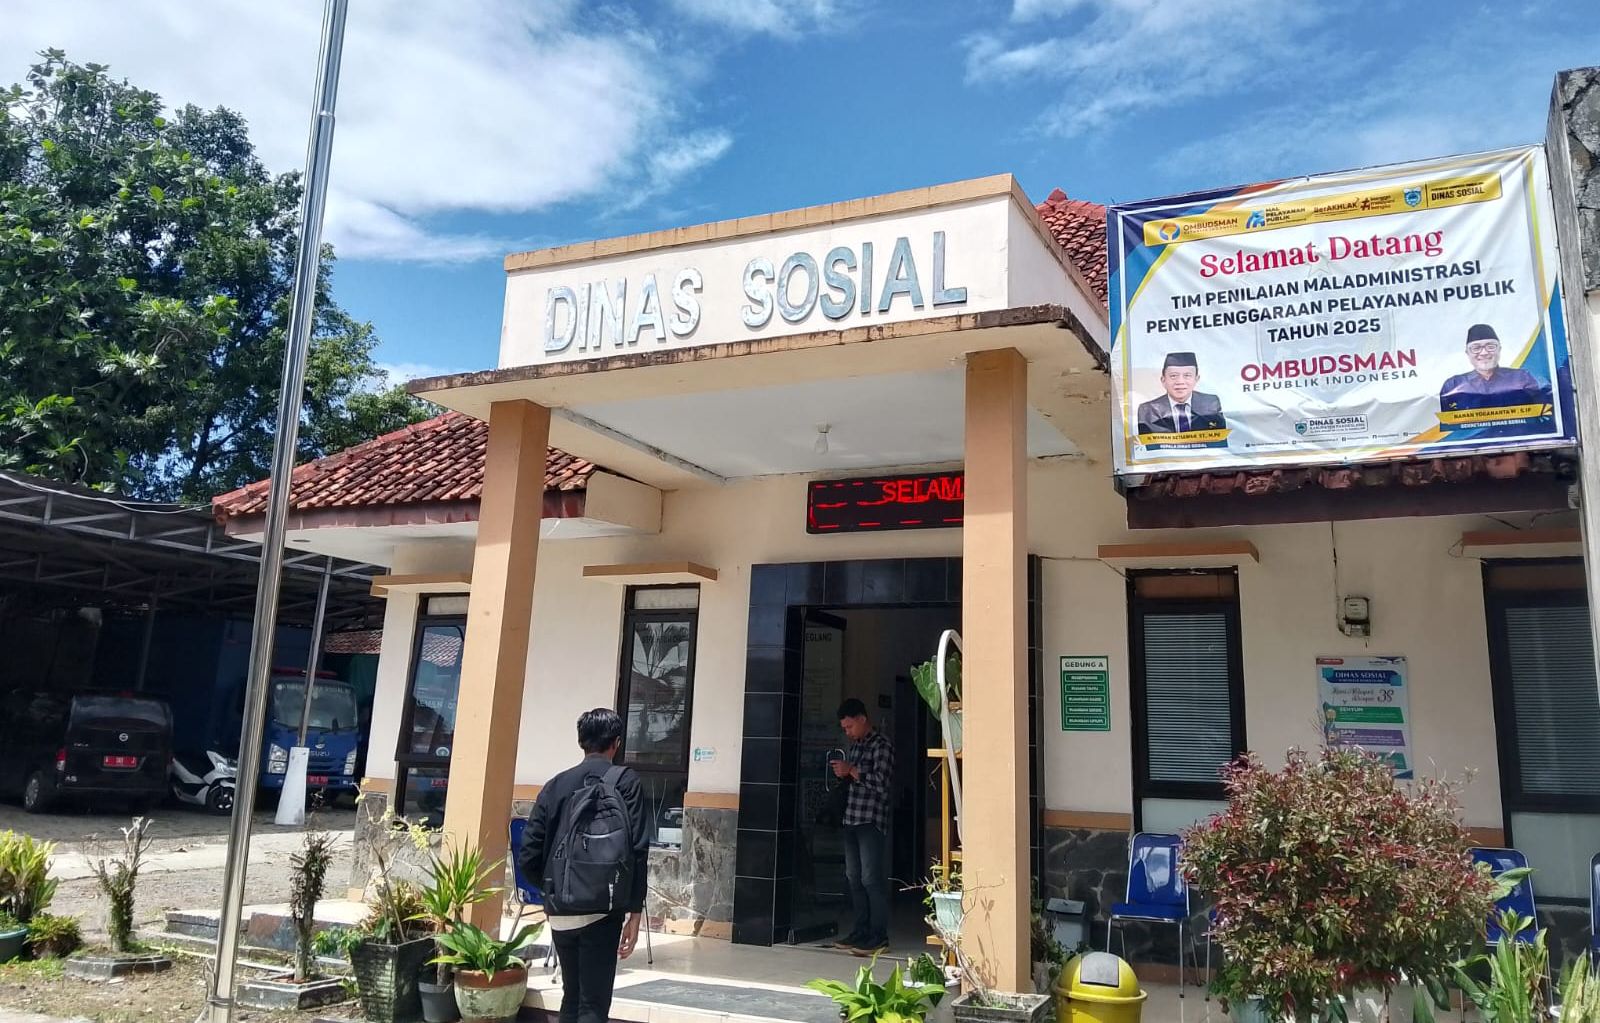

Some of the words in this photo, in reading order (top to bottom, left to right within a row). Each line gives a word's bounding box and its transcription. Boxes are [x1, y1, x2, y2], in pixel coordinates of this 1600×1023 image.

[1431, 191, 1455, 201] DINAS
[1457, 187, 1486, 198] SOSIAL
[1183, 218, 1238, 231] OMBUDSMAN
[1265, 208, 1306, 217] PELAYANAN
[1265, 214, 1291, 222] PUBLIK
[1200, 241, 1320, 277] Selamat
[1328, 230, 1444, 261] Datang
[543, 266, 703, 353] DINAS
[741, 230, 968, 329] SOSIAL
[1171, 294, 1201, 310] TIM
[1205, 281, 1299, 306] PENILAIAN
[1304, 260, 1481, 293] MALADMINISTRASI
[1146, 300, 1323, 334] PENYELENGGARAAN
[1328, 289, 1438, 313] PELAYANAN
[1443, 279, 1516, 302] PUBLIK
[1267, 322, 1329, 343] TAHUN
[1333, 318, 1381, 335] 2025
[1240, 349, 1417, 382] OMBUDSMAN
[1242, 378, 1319, 393] REPUBLIK
[1325, 369, 1418, 385] INDONESIA
[1309, 418, 1334, 426] DINAS
[1335, 416, 1364, 425] SOSIAL
[882, 476, 964, 502] SELAM
[1335, 671, 1359, 679] DINAS
